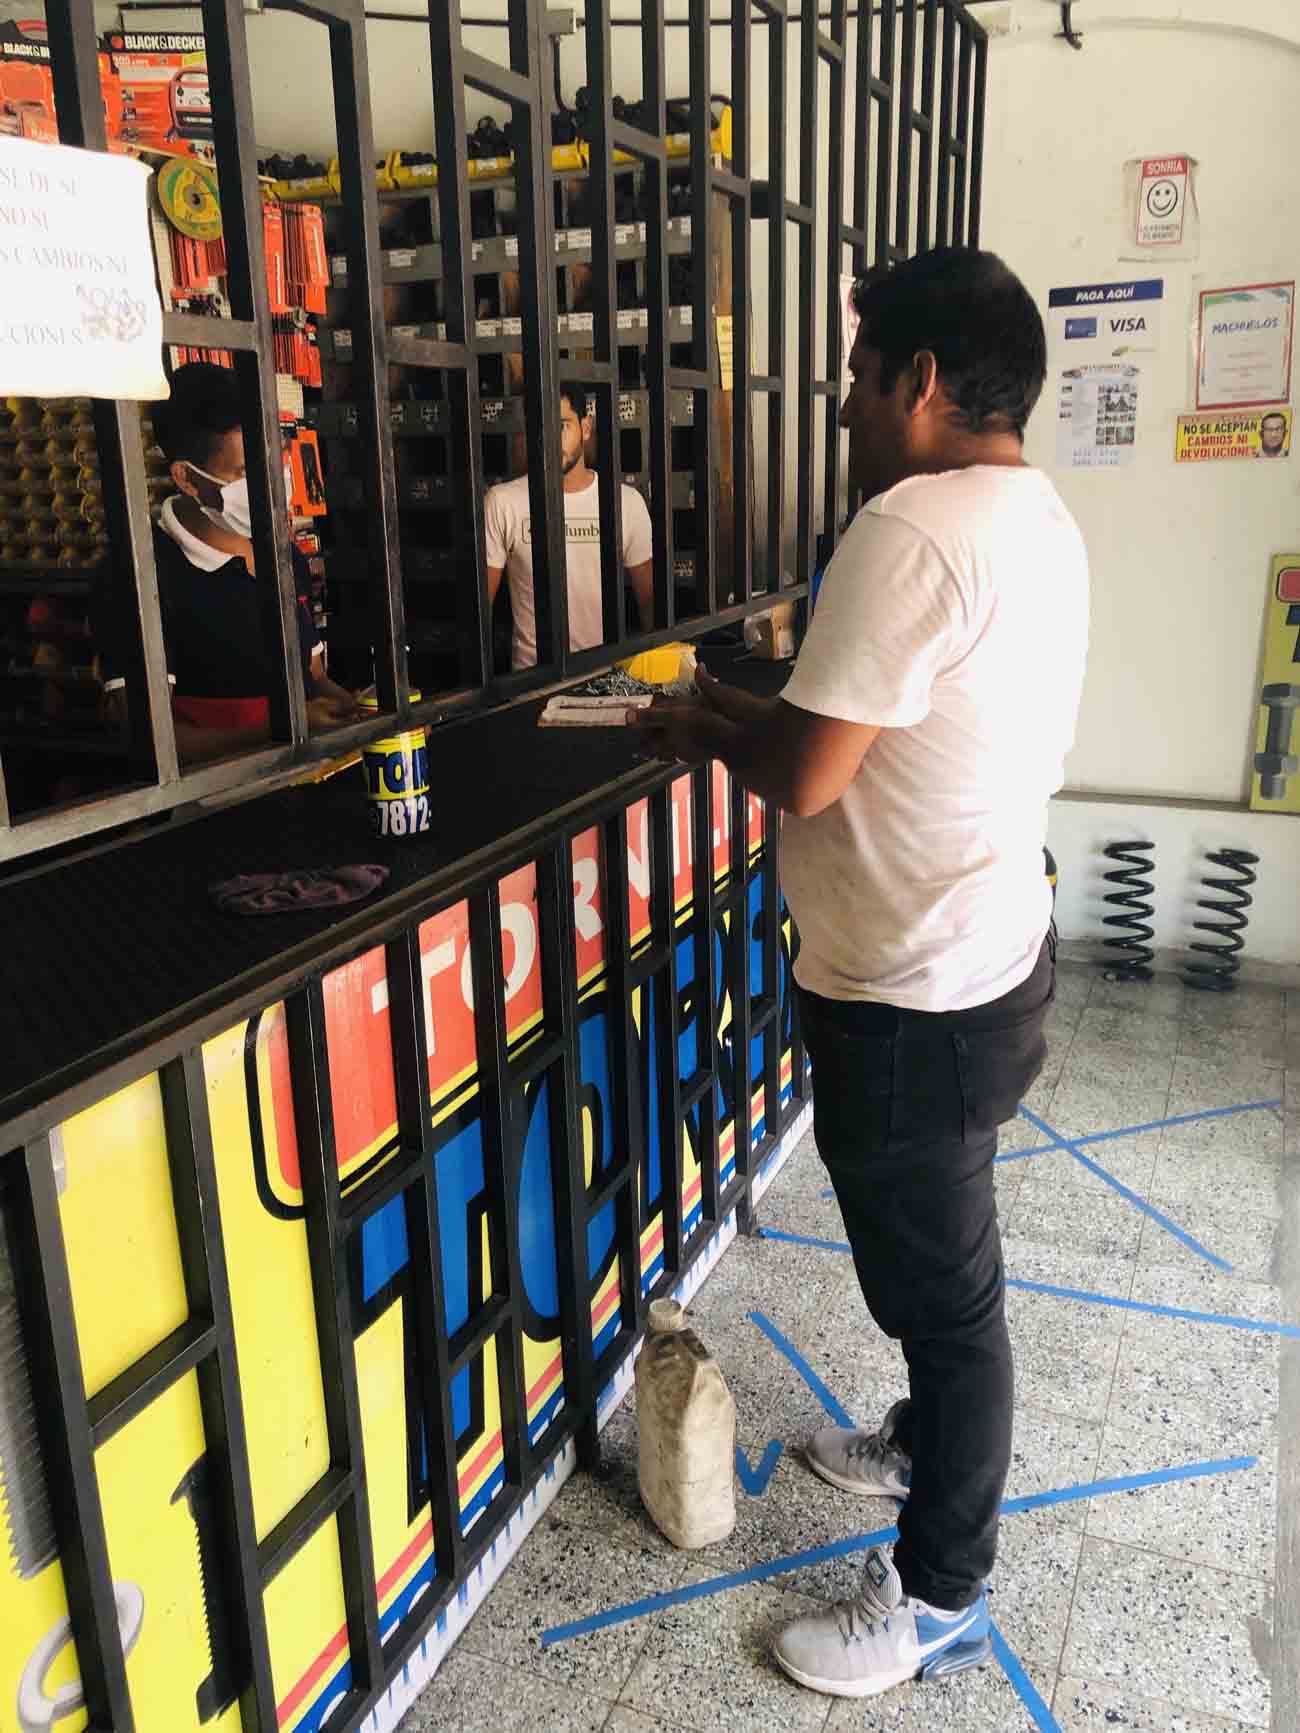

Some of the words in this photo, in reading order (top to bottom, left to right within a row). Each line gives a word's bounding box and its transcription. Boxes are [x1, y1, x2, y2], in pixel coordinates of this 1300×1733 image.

[124, 34, 206, 51] BLACK&DECKE
[1075, 290, 1105, 303] PAGA
[1106, 285, 1135, 300] AQUÍ
[1110, 317, 1148, 333] VISA
[1184, 423, 1198, 435] NO
[1199, 422, 1211, 434] SE
[1214, 420, 1258, 433] ACEPTAN
[1187, 435, 1233, 447] CAMBIOS
[1237, 433, 1249, 445] NI
